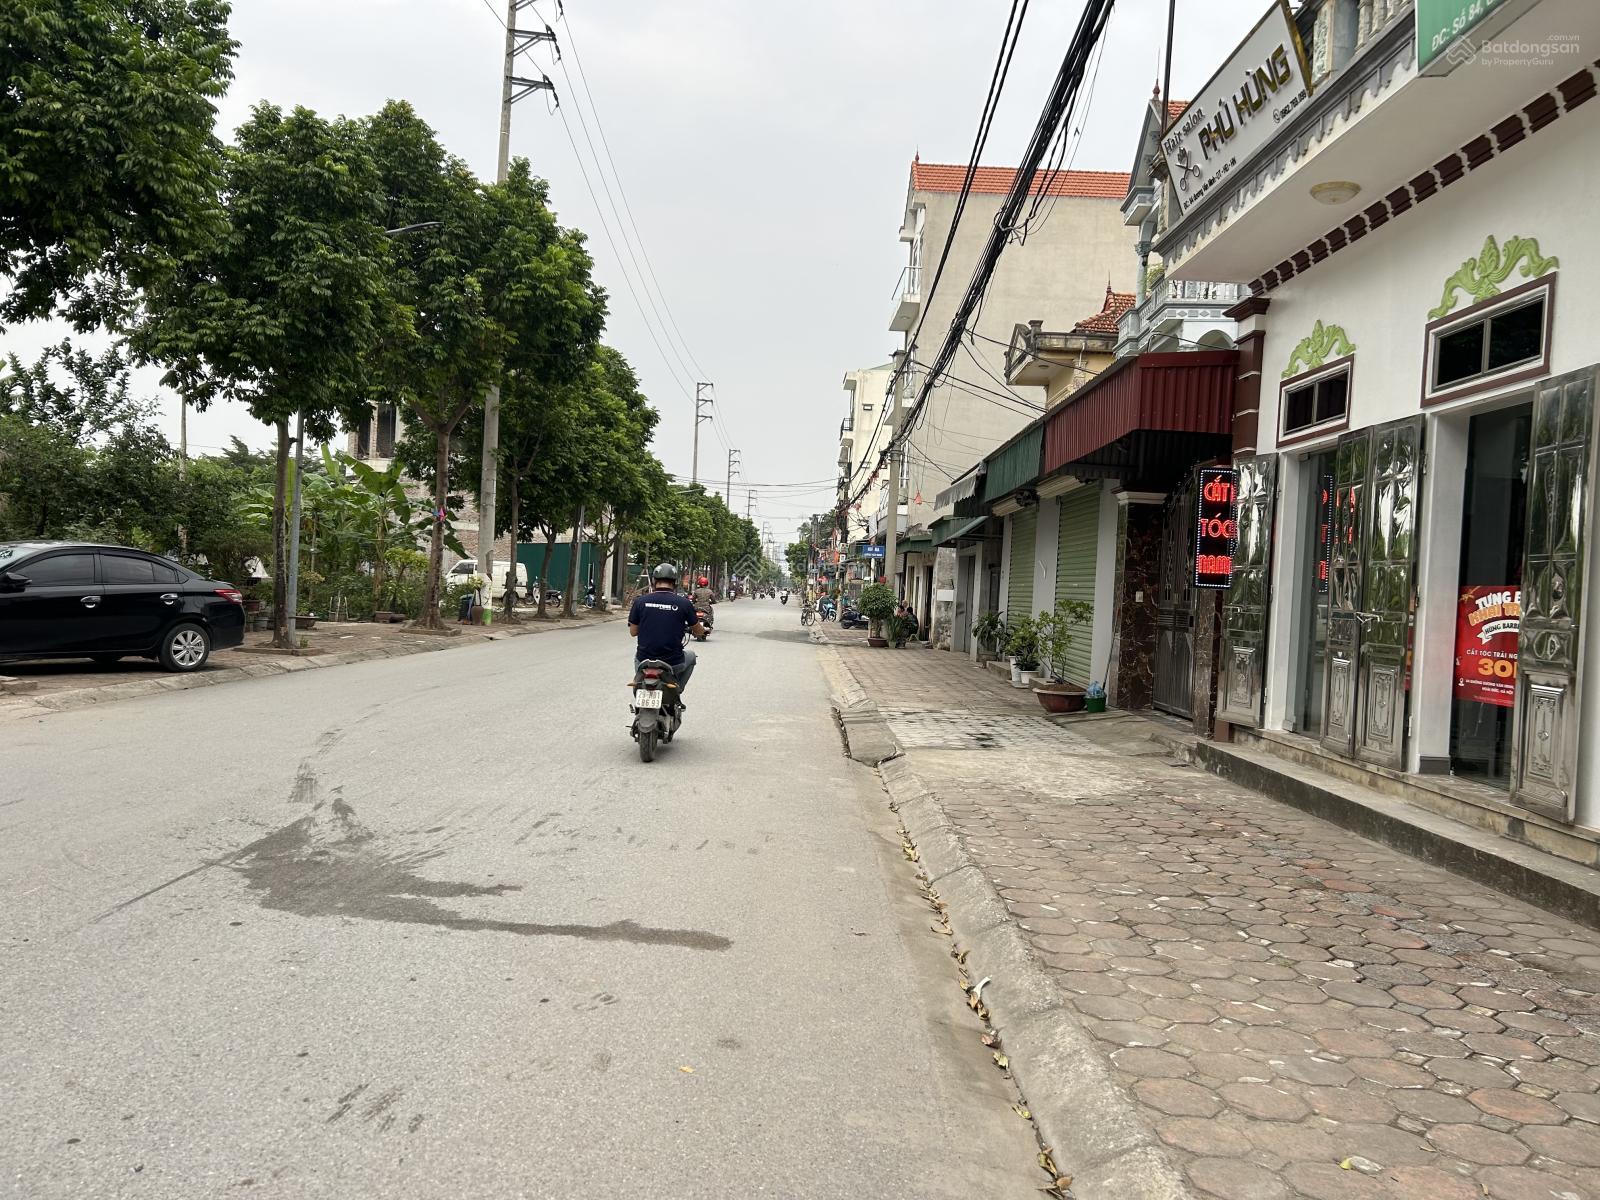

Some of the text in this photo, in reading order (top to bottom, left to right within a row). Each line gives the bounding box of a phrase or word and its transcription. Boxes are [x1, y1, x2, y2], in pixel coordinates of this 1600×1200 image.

[1197, 43, 1290, 160] PHÚ HÙNG
[1163, 108, 1205, 155] Hair salon
[1203, 475, 1230, 502] CẮT
[1200, 512, 1232, 538] TÓC
[1468, 604, 1502, 626] KHAI
